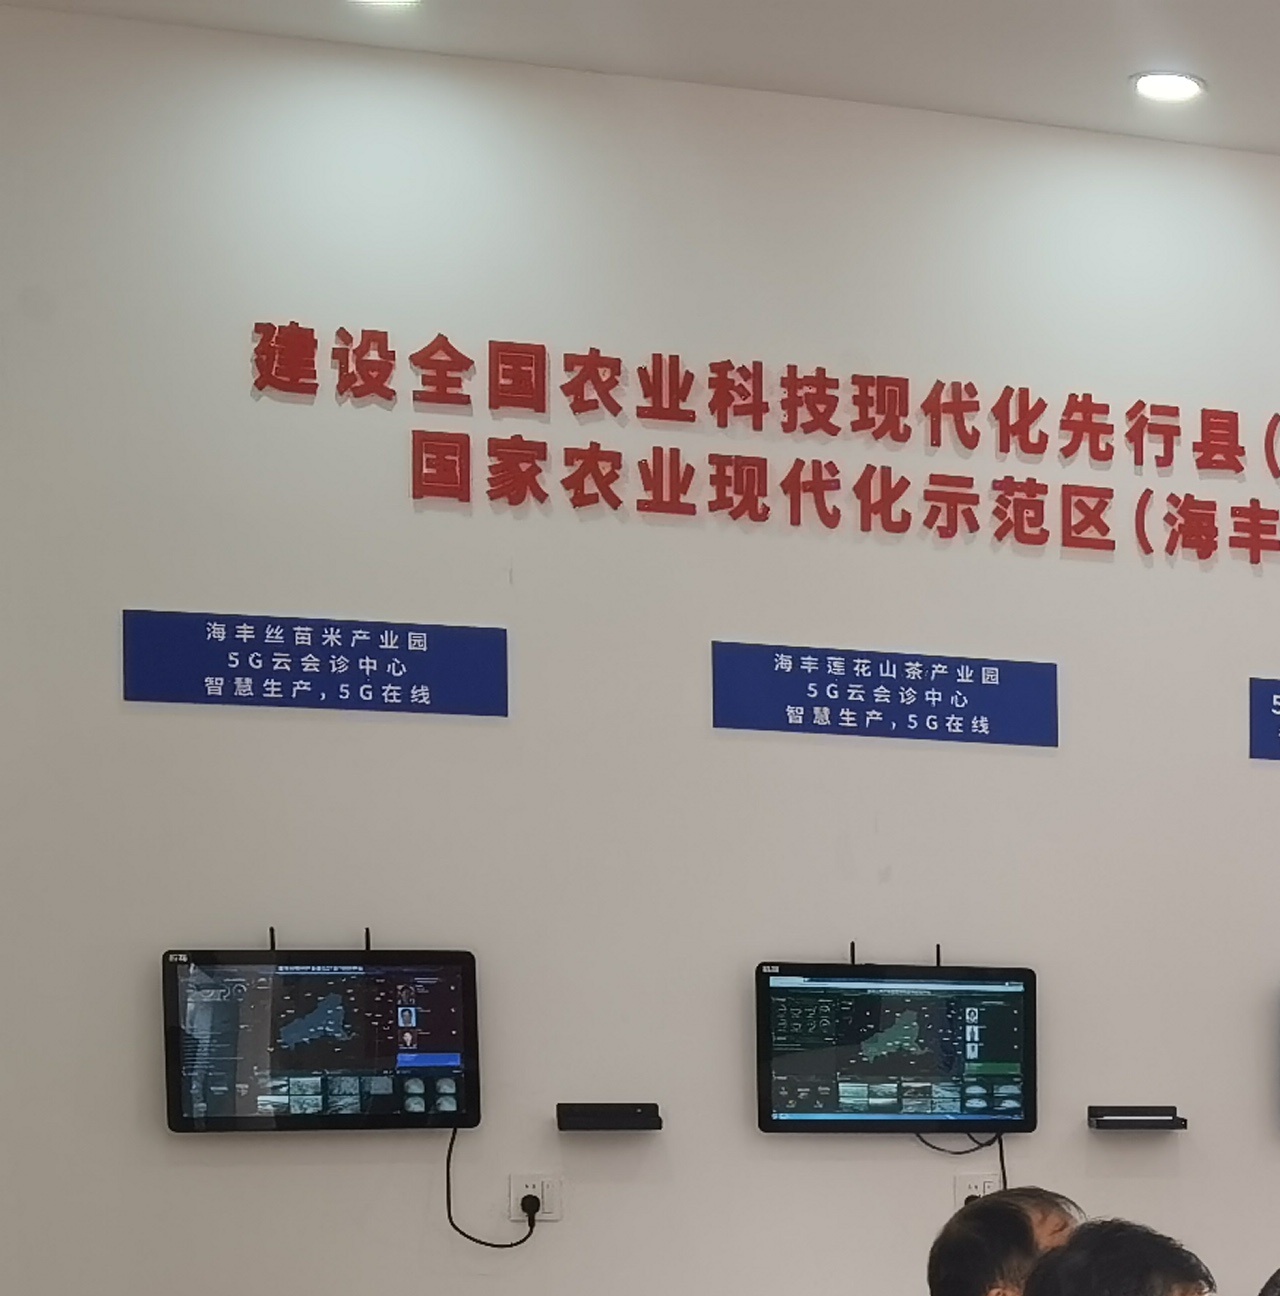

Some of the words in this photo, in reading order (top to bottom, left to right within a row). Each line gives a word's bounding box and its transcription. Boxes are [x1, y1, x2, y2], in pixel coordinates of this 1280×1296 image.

[205, 620, 429, 652] 海丰丝苗米产业园
[226, 651, 408, 677] 5G云会诊中心
[773, 652, 1000, 685] 海丰莲花山茶产业园
[805, 682, 970, 708] 5G云会诊中心
